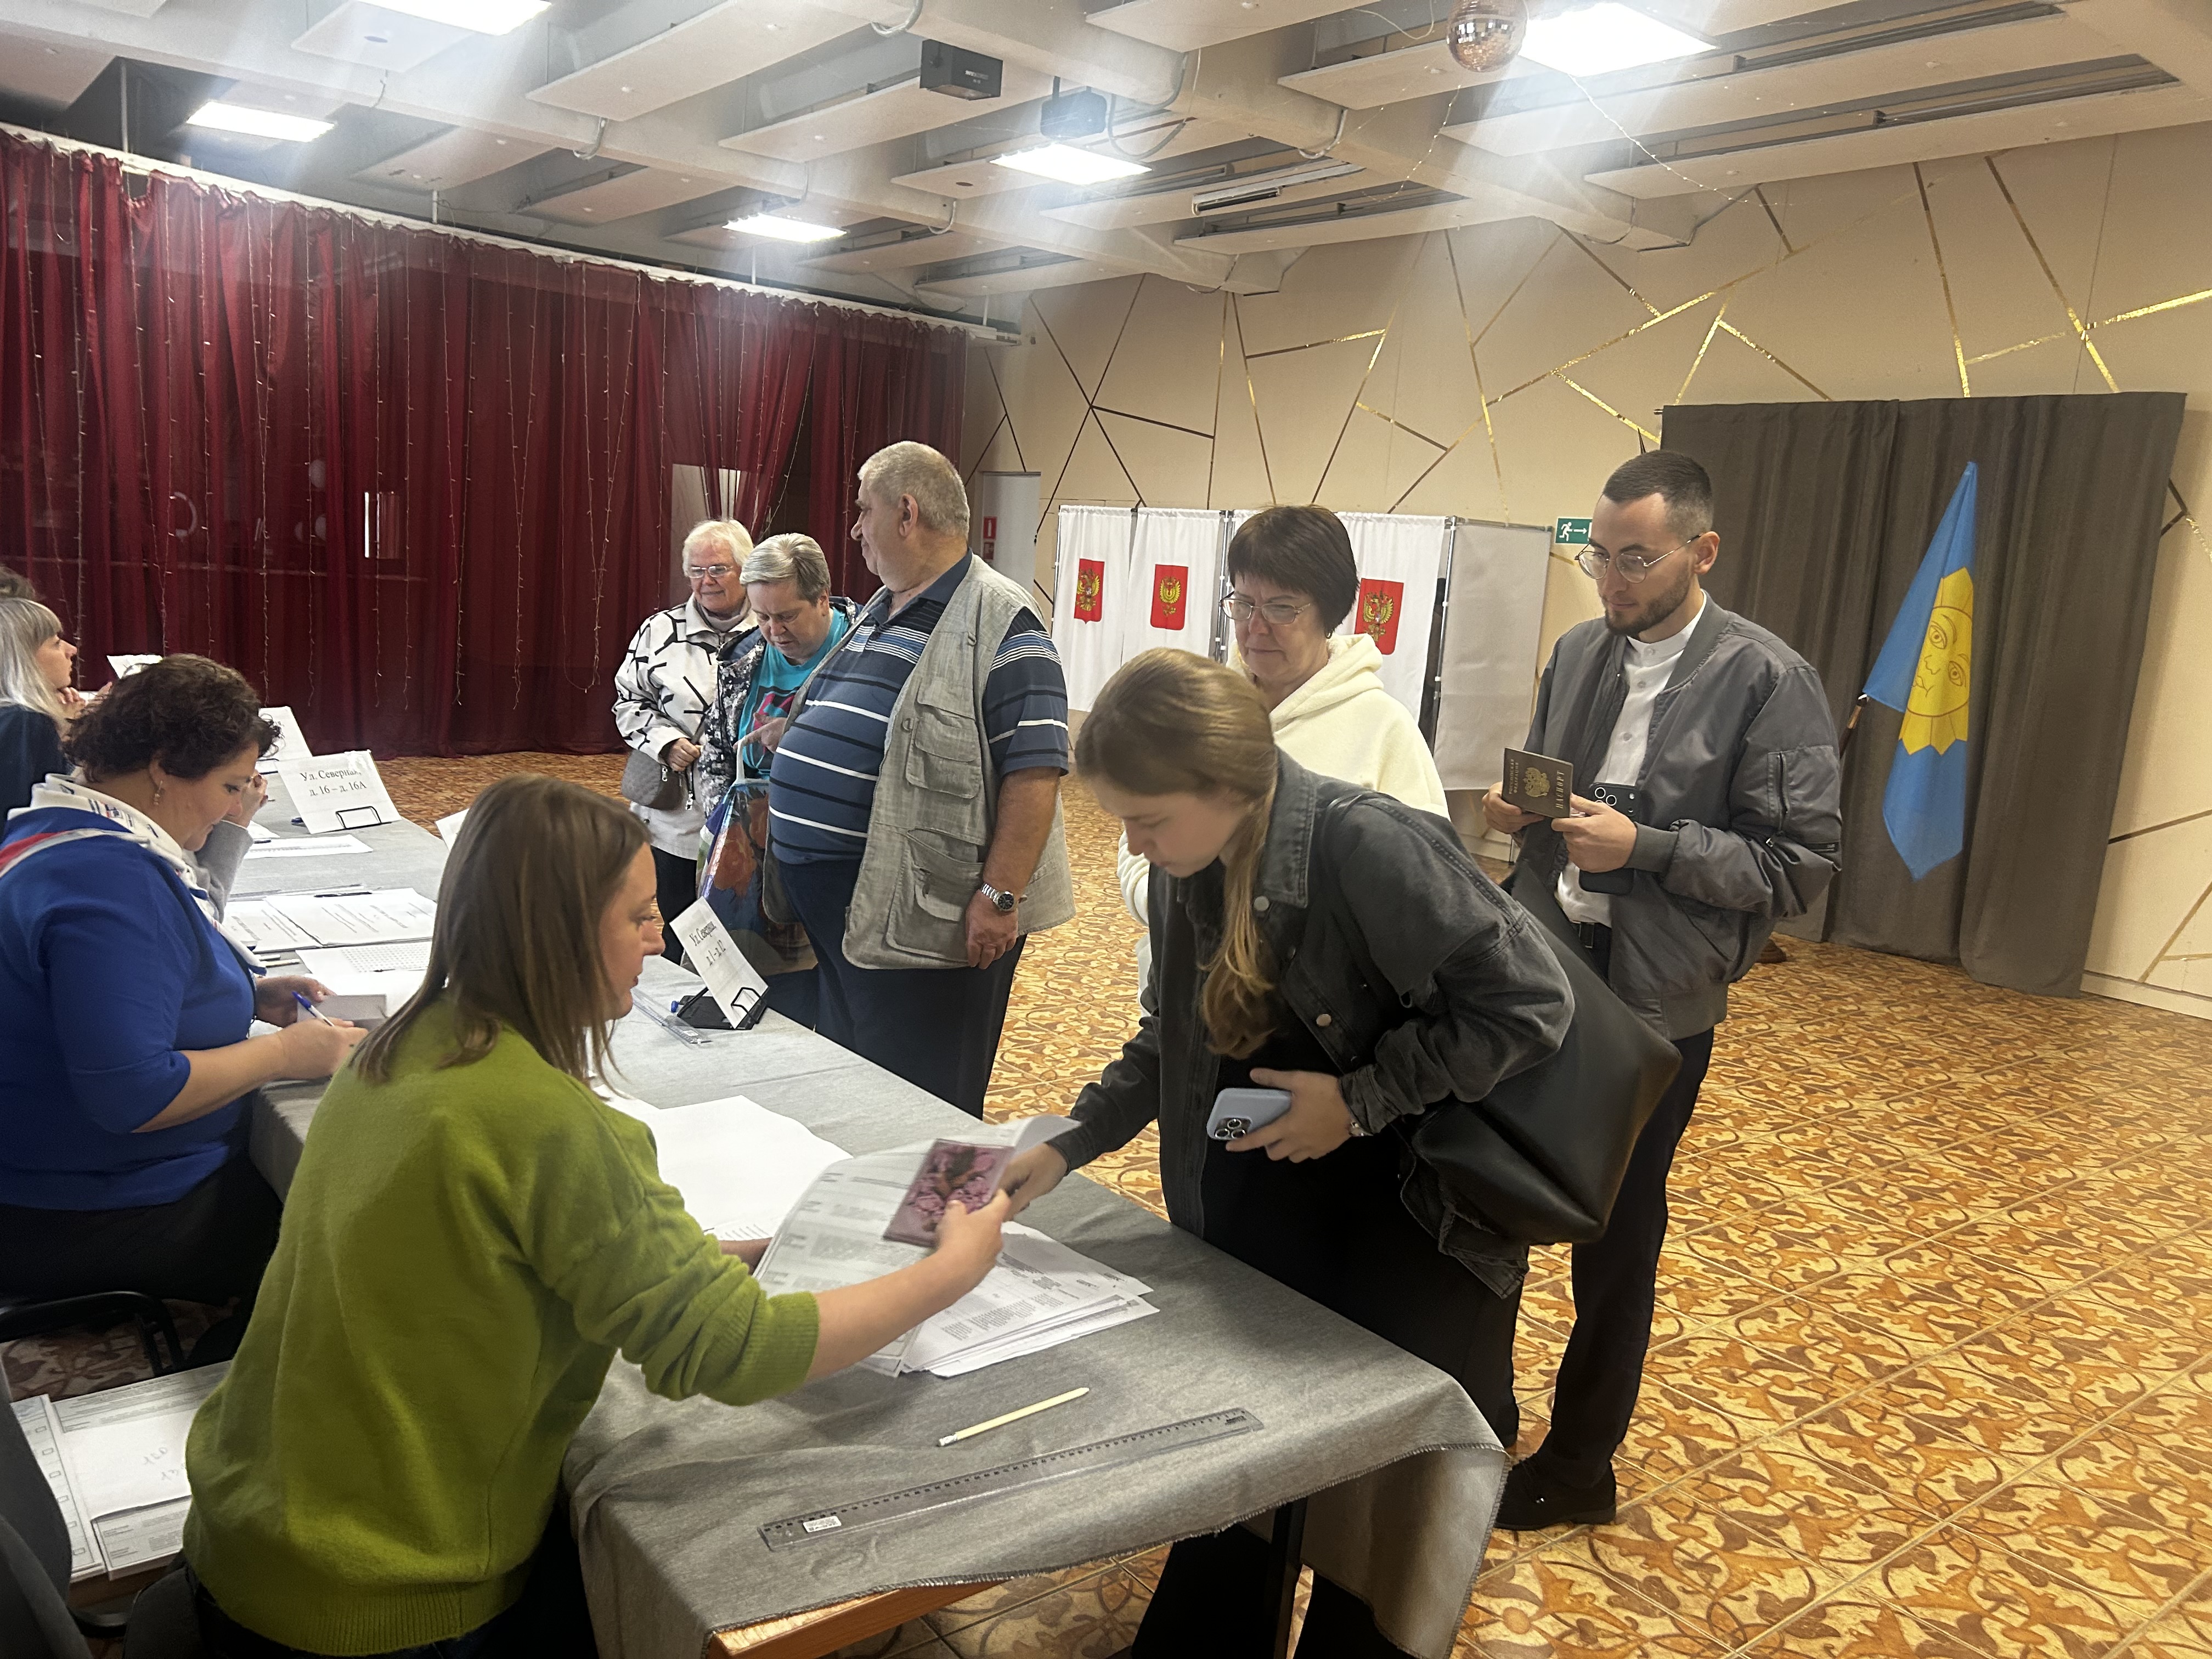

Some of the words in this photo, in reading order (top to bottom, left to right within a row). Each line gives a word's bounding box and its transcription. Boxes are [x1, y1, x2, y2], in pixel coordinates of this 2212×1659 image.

[300, 772, 318, 781] Ул.
[319, 785, 330, 794] 16
[1555, 770, 1564, 809] ПАСПОРТ
